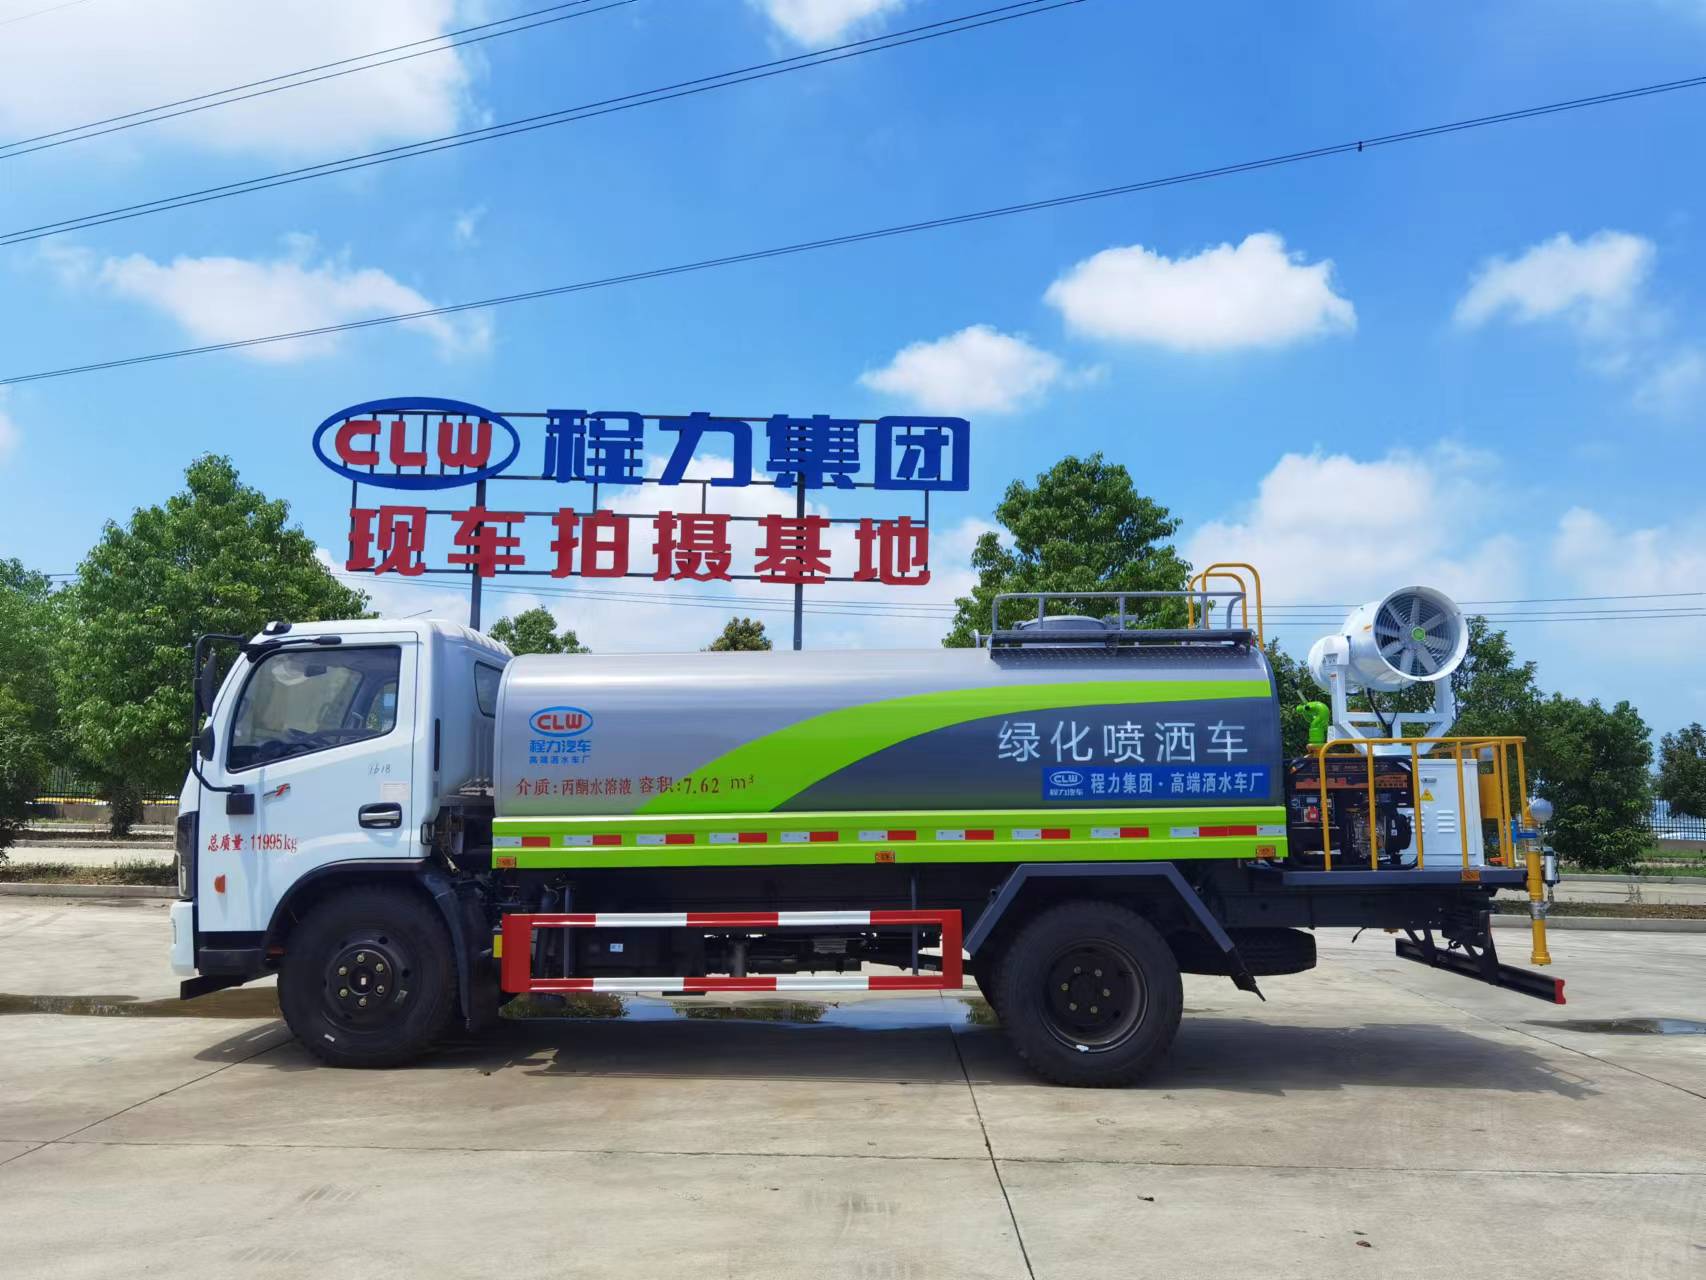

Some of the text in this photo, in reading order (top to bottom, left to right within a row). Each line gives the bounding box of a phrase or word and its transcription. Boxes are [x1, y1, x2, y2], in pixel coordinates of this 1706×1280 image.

[335, 420, 493, 468] CLW
[543, 408, 971, 491] 程力集团
[346, 506, 930, 586] 现车拍摄基地
[537, 713, 583, 730] CLW
[998, 719, 1249, 763] 绿化喷洒车
[529, 739, 592, 753] 程力汽车
[1053, 774, 1078, 783] CLW
